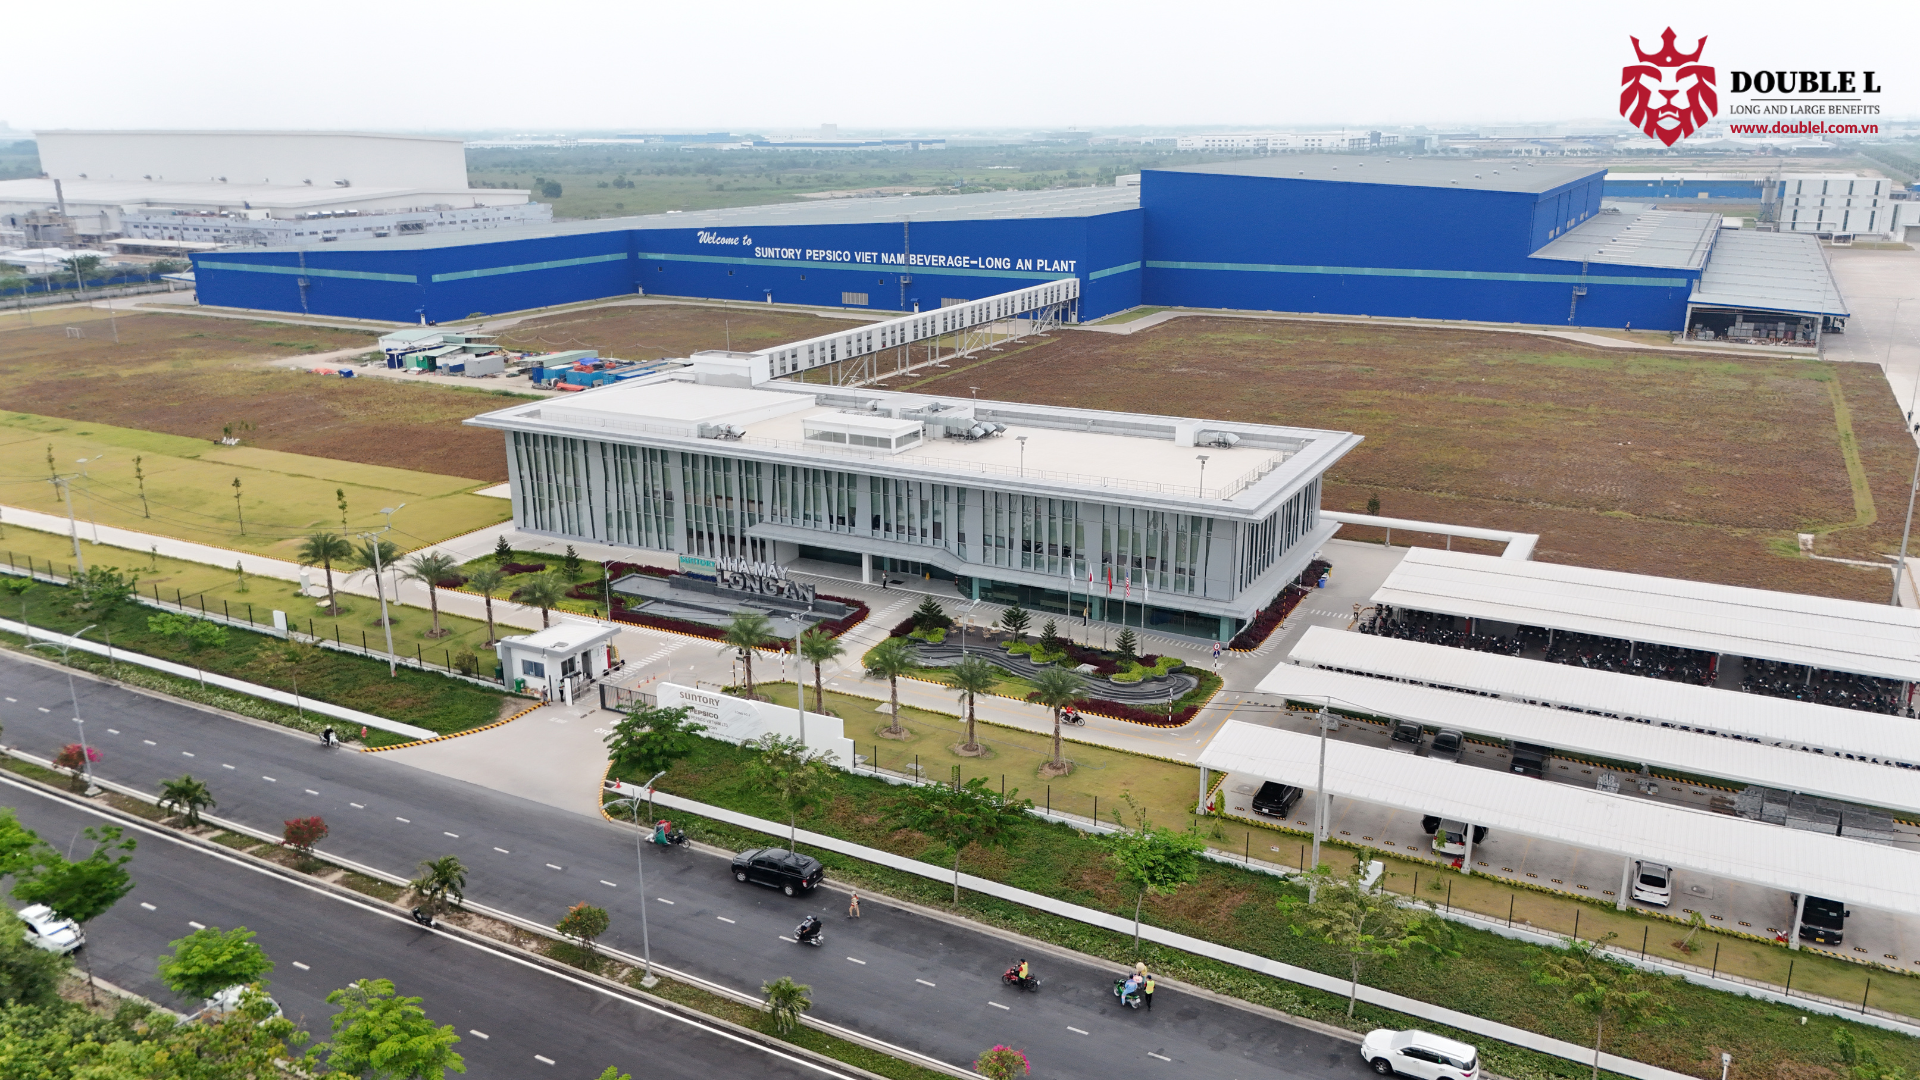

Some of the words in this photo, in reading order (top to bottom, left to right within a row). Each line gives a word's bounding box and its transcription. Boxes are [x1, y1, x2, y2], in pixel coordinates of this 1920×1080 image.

[697, 231, 740, 246] Welcome
[742, 234, 753, 246] to
[754, 246, 802, 260] SUNTORY
[805, 249, 851, 262] PEPSICO
[854, 251, 878, 263] VIET
[881, 252, 905, 265] NAM
[1015, 258, 1033, 271] AN
[1036, 259, 1077, 273] PLANT
[680, 555, 716, 568] SUNTORY
[716, 555, 750, 574] NHÀ
[754, 560, 789, 580] MÁY
[716, 570, 779, 597] LONG
[783, 580, 816, 605] AN
[679, 691, 720, 707] SUNTORY
[690, 707, 719, 720] PEPSICO
